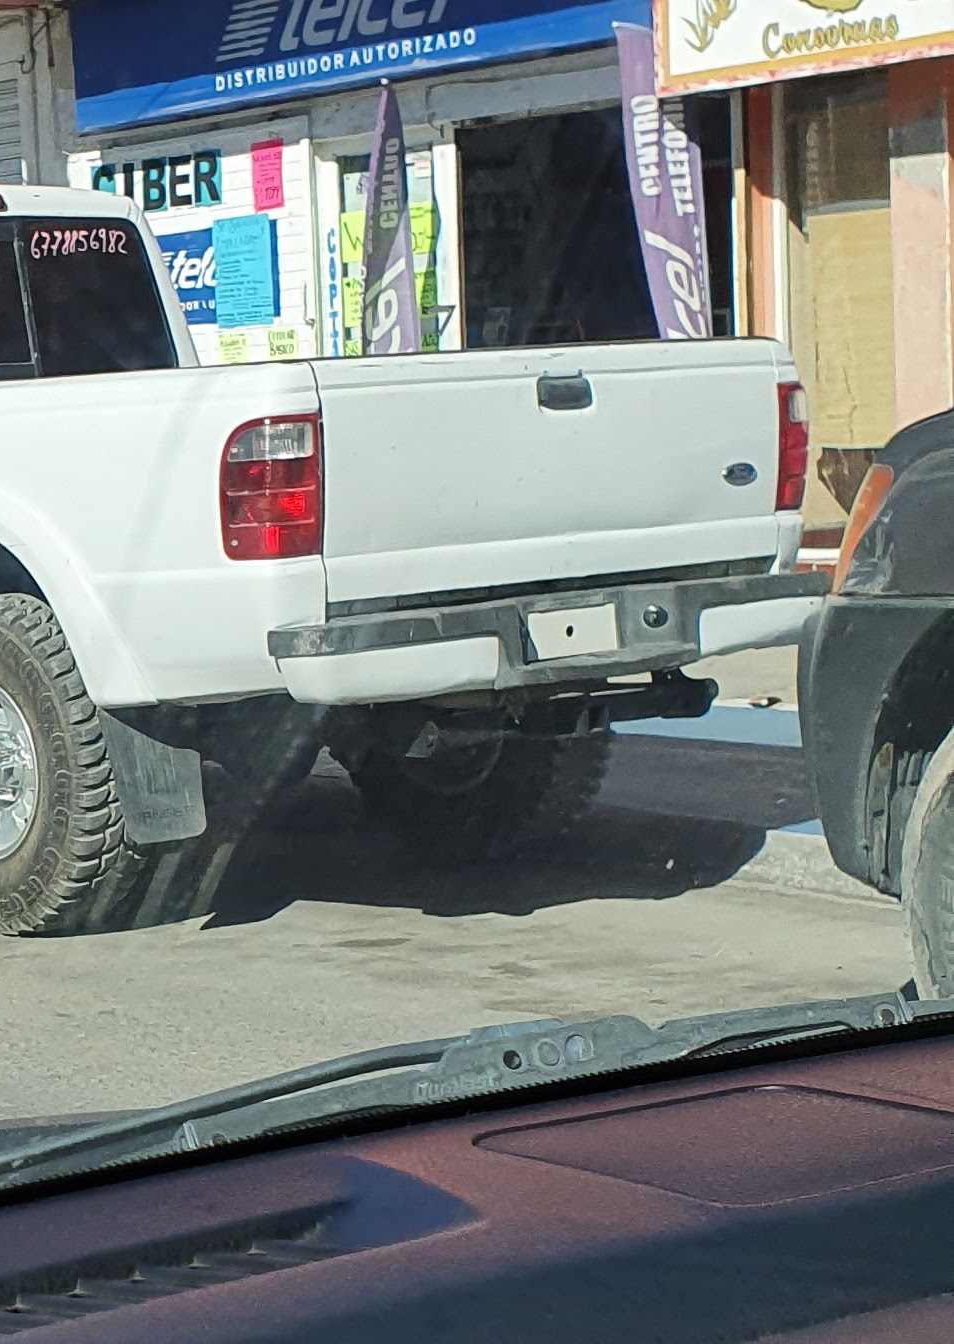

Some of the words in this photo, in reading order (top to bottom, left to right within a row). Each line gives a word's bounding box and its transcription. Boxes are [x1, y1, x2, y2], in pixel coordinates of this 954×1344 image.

[214, 54, 347, 92] DISTRIBUIDOR
[349, 28, 477, 68] AUTORIZADO
[631, 95, 661, 197] CENTRO
[93, 150, 221, 211] CIBER
